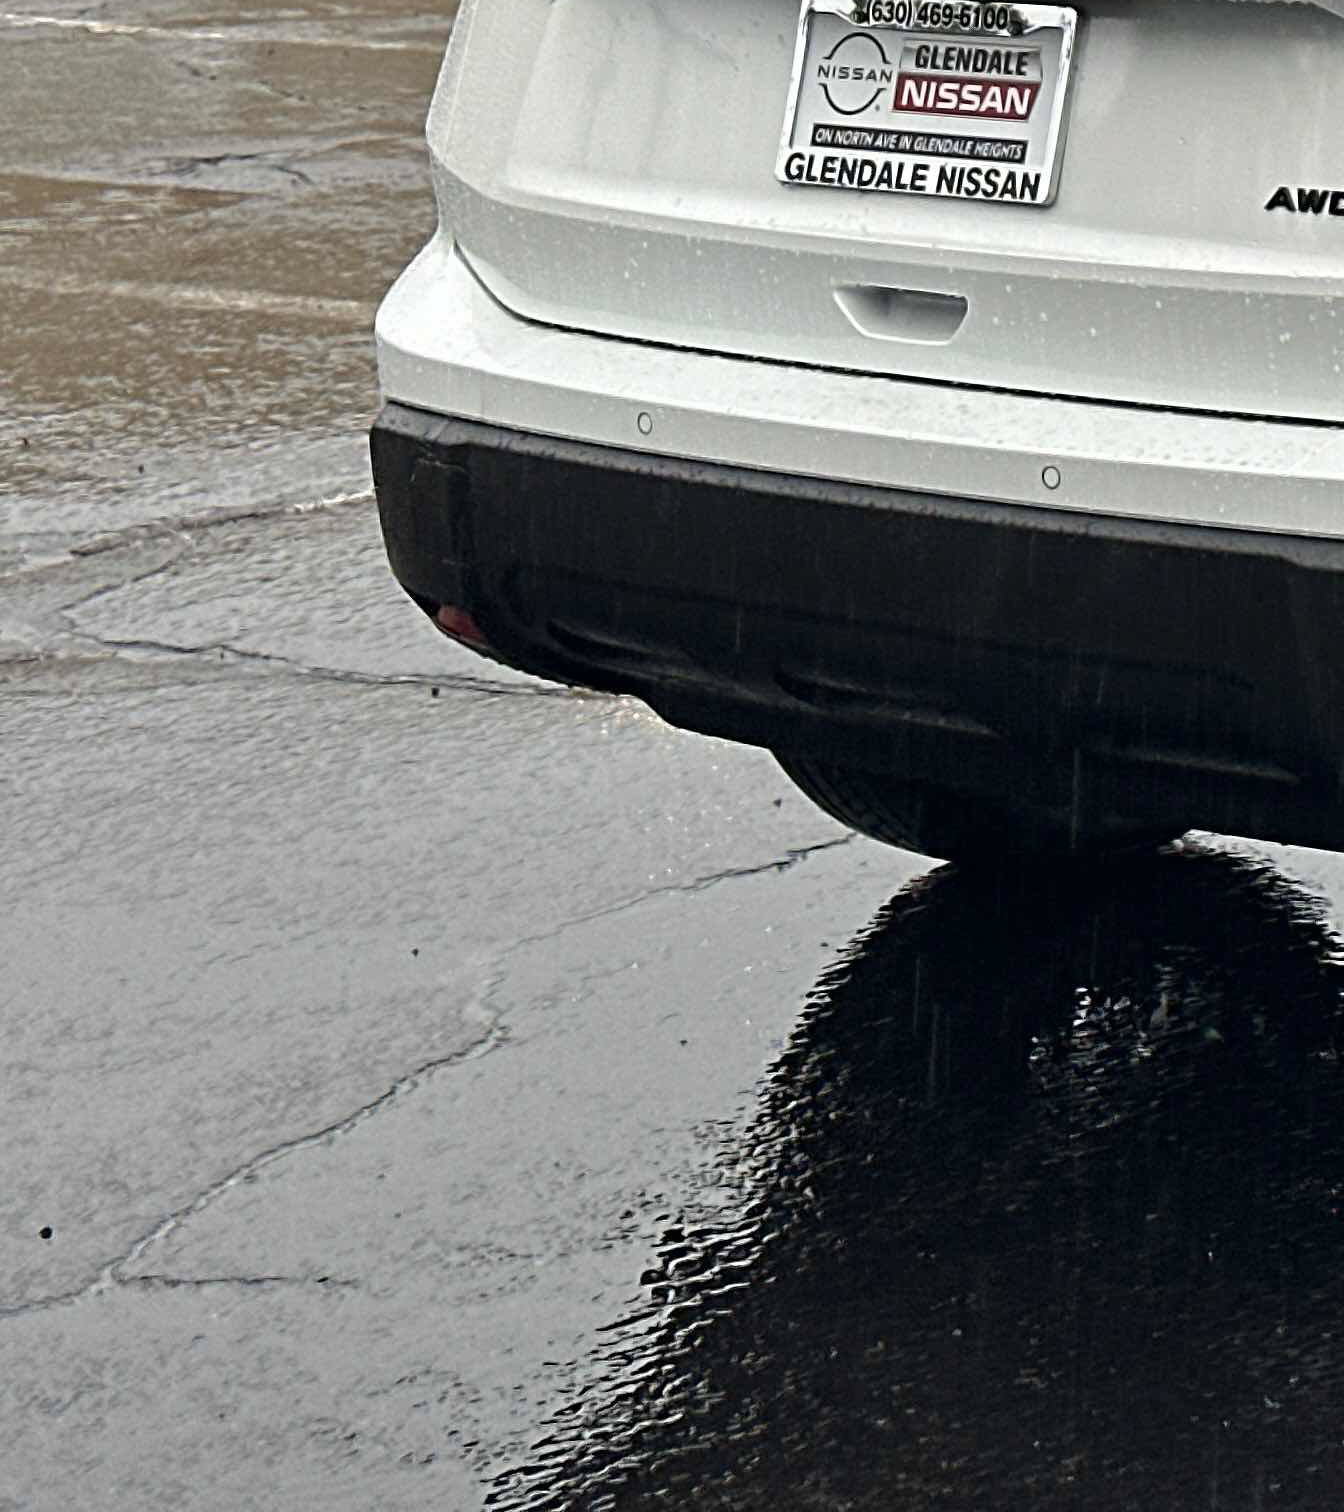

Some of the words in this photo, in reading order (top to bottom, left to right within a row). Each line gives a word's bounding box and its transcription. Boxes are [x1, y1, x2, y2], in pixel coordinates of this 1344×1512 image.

[916, 1, 1009, 31] 469-6100
[817, 64, 893, 84] NISSAN
[914, 44, 1031, 76] GLENDALE
[901, 79, 1031, 116] NISSAN
[815, 128, 834, 143] ON
[833, 130, 873, 146] NORTH
[875, 132, 898, 149] AVE
[898, 135, 913, 150] IN
[914, 136, 973, 155] GLENDALE
[974, 141, 1023, 159] HEIGHTS
[784, 152, 930, 192] GLENDALE
[936, 163, 1042, 202] NISSAN
